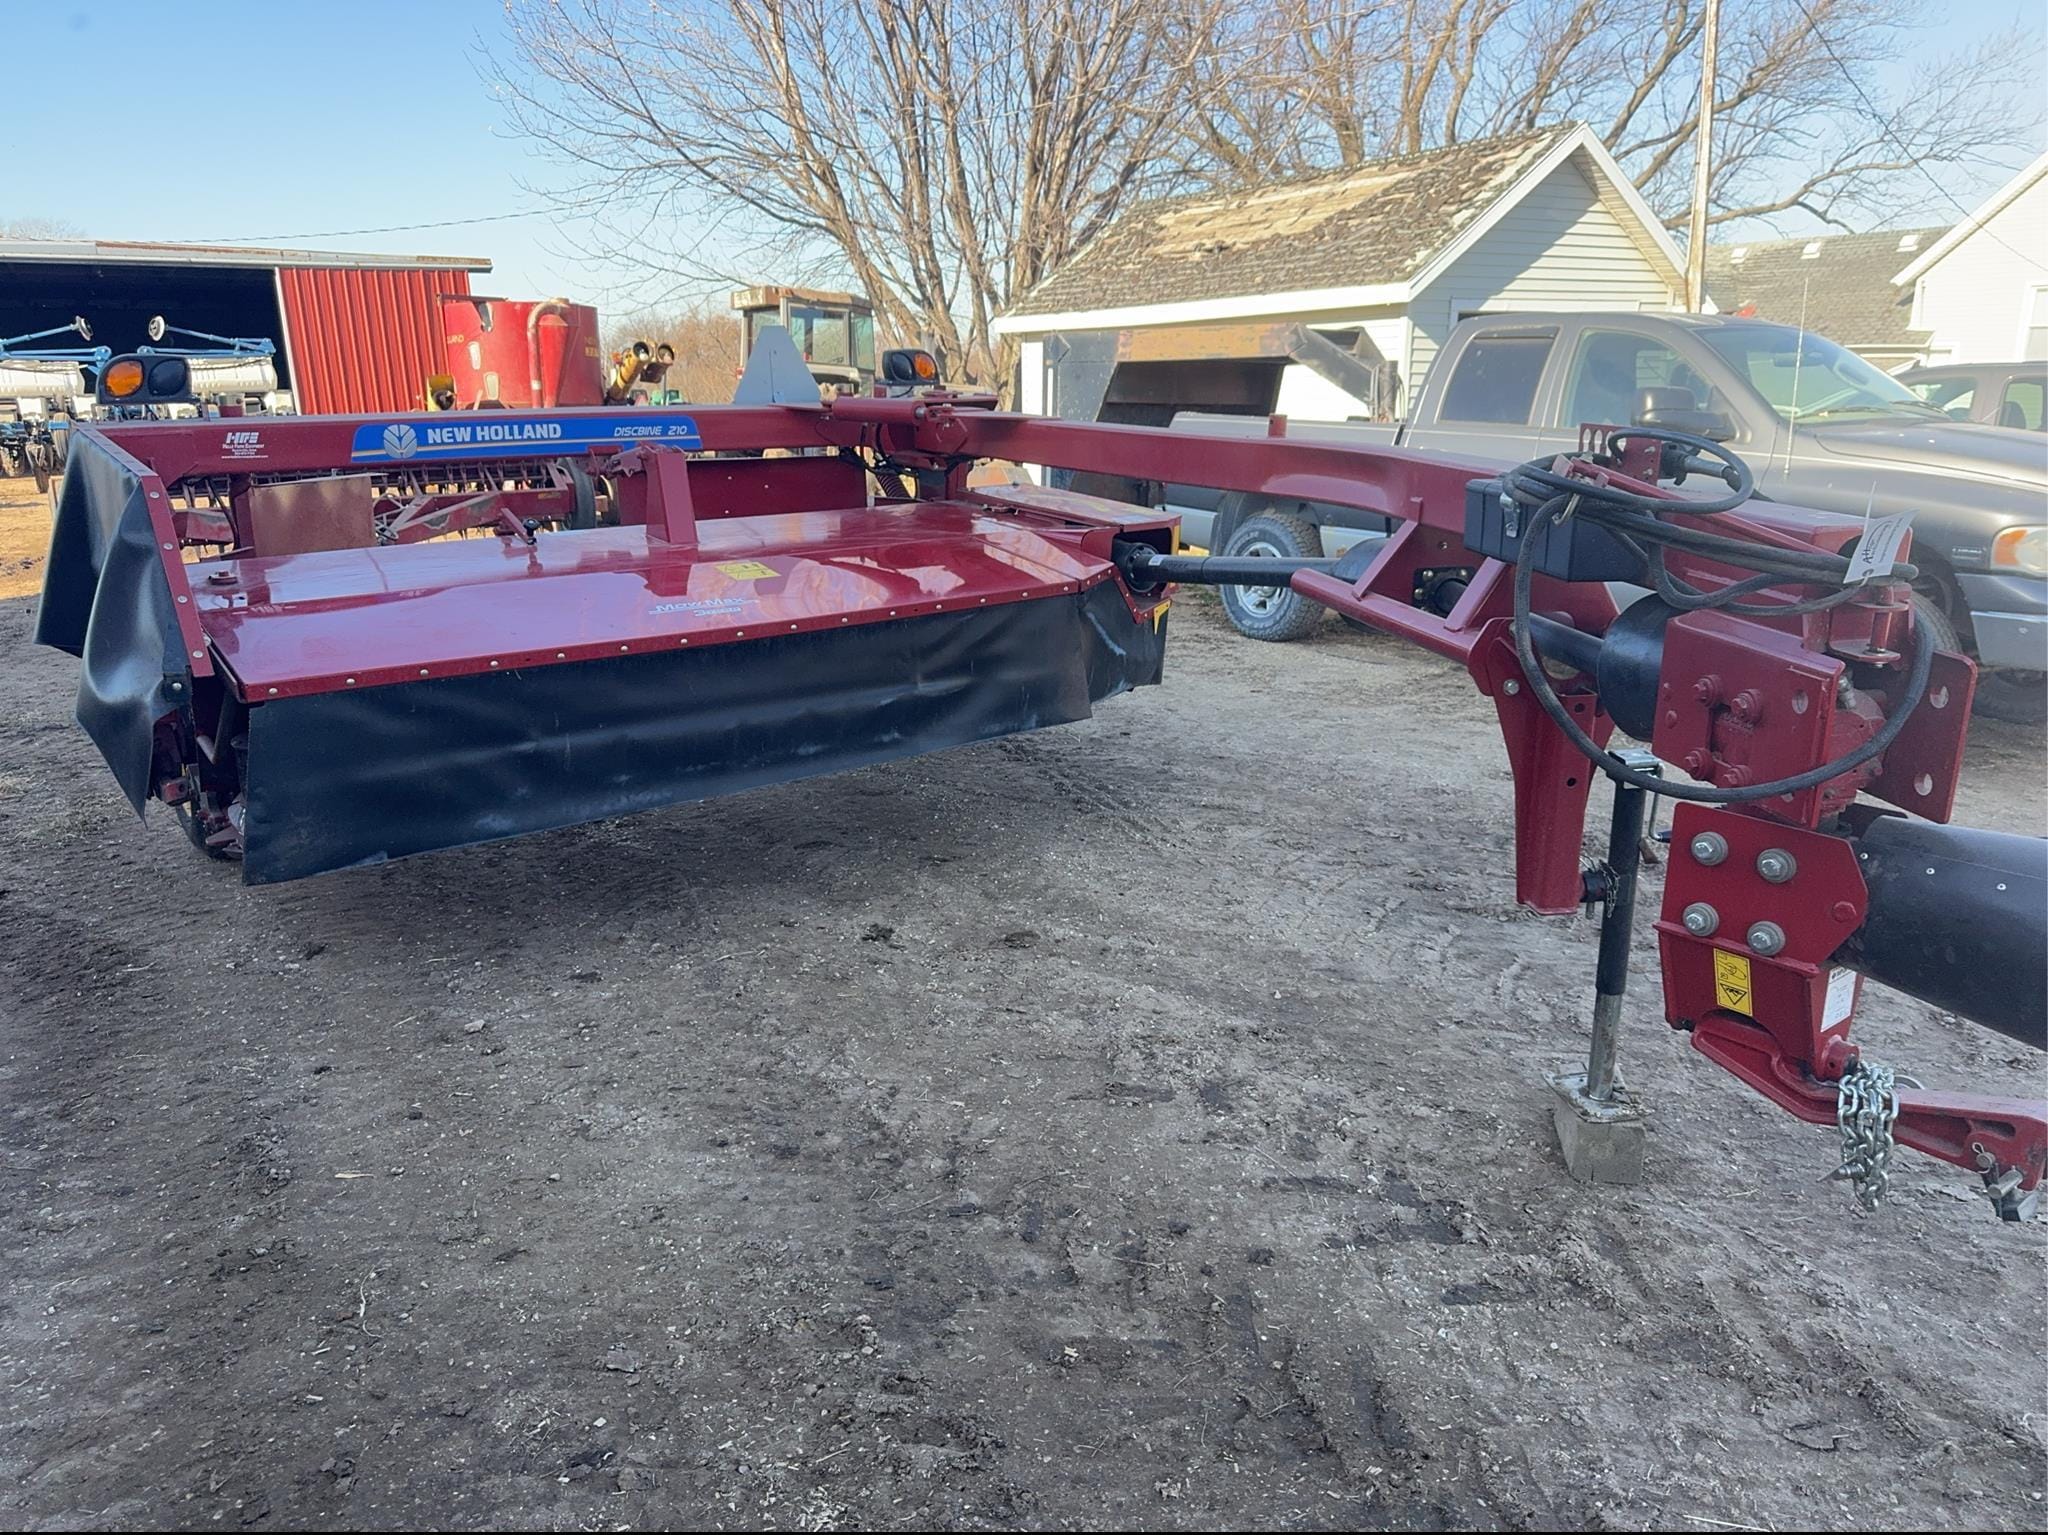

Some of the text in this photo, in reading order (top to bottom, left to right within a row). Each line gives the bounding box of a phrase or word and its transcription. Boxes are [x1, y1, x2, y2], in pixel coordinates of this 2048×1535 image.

[427, 423, 562, 444] NEW HOLLAND
[614, 425, 688, 437] DISCBINE 210
